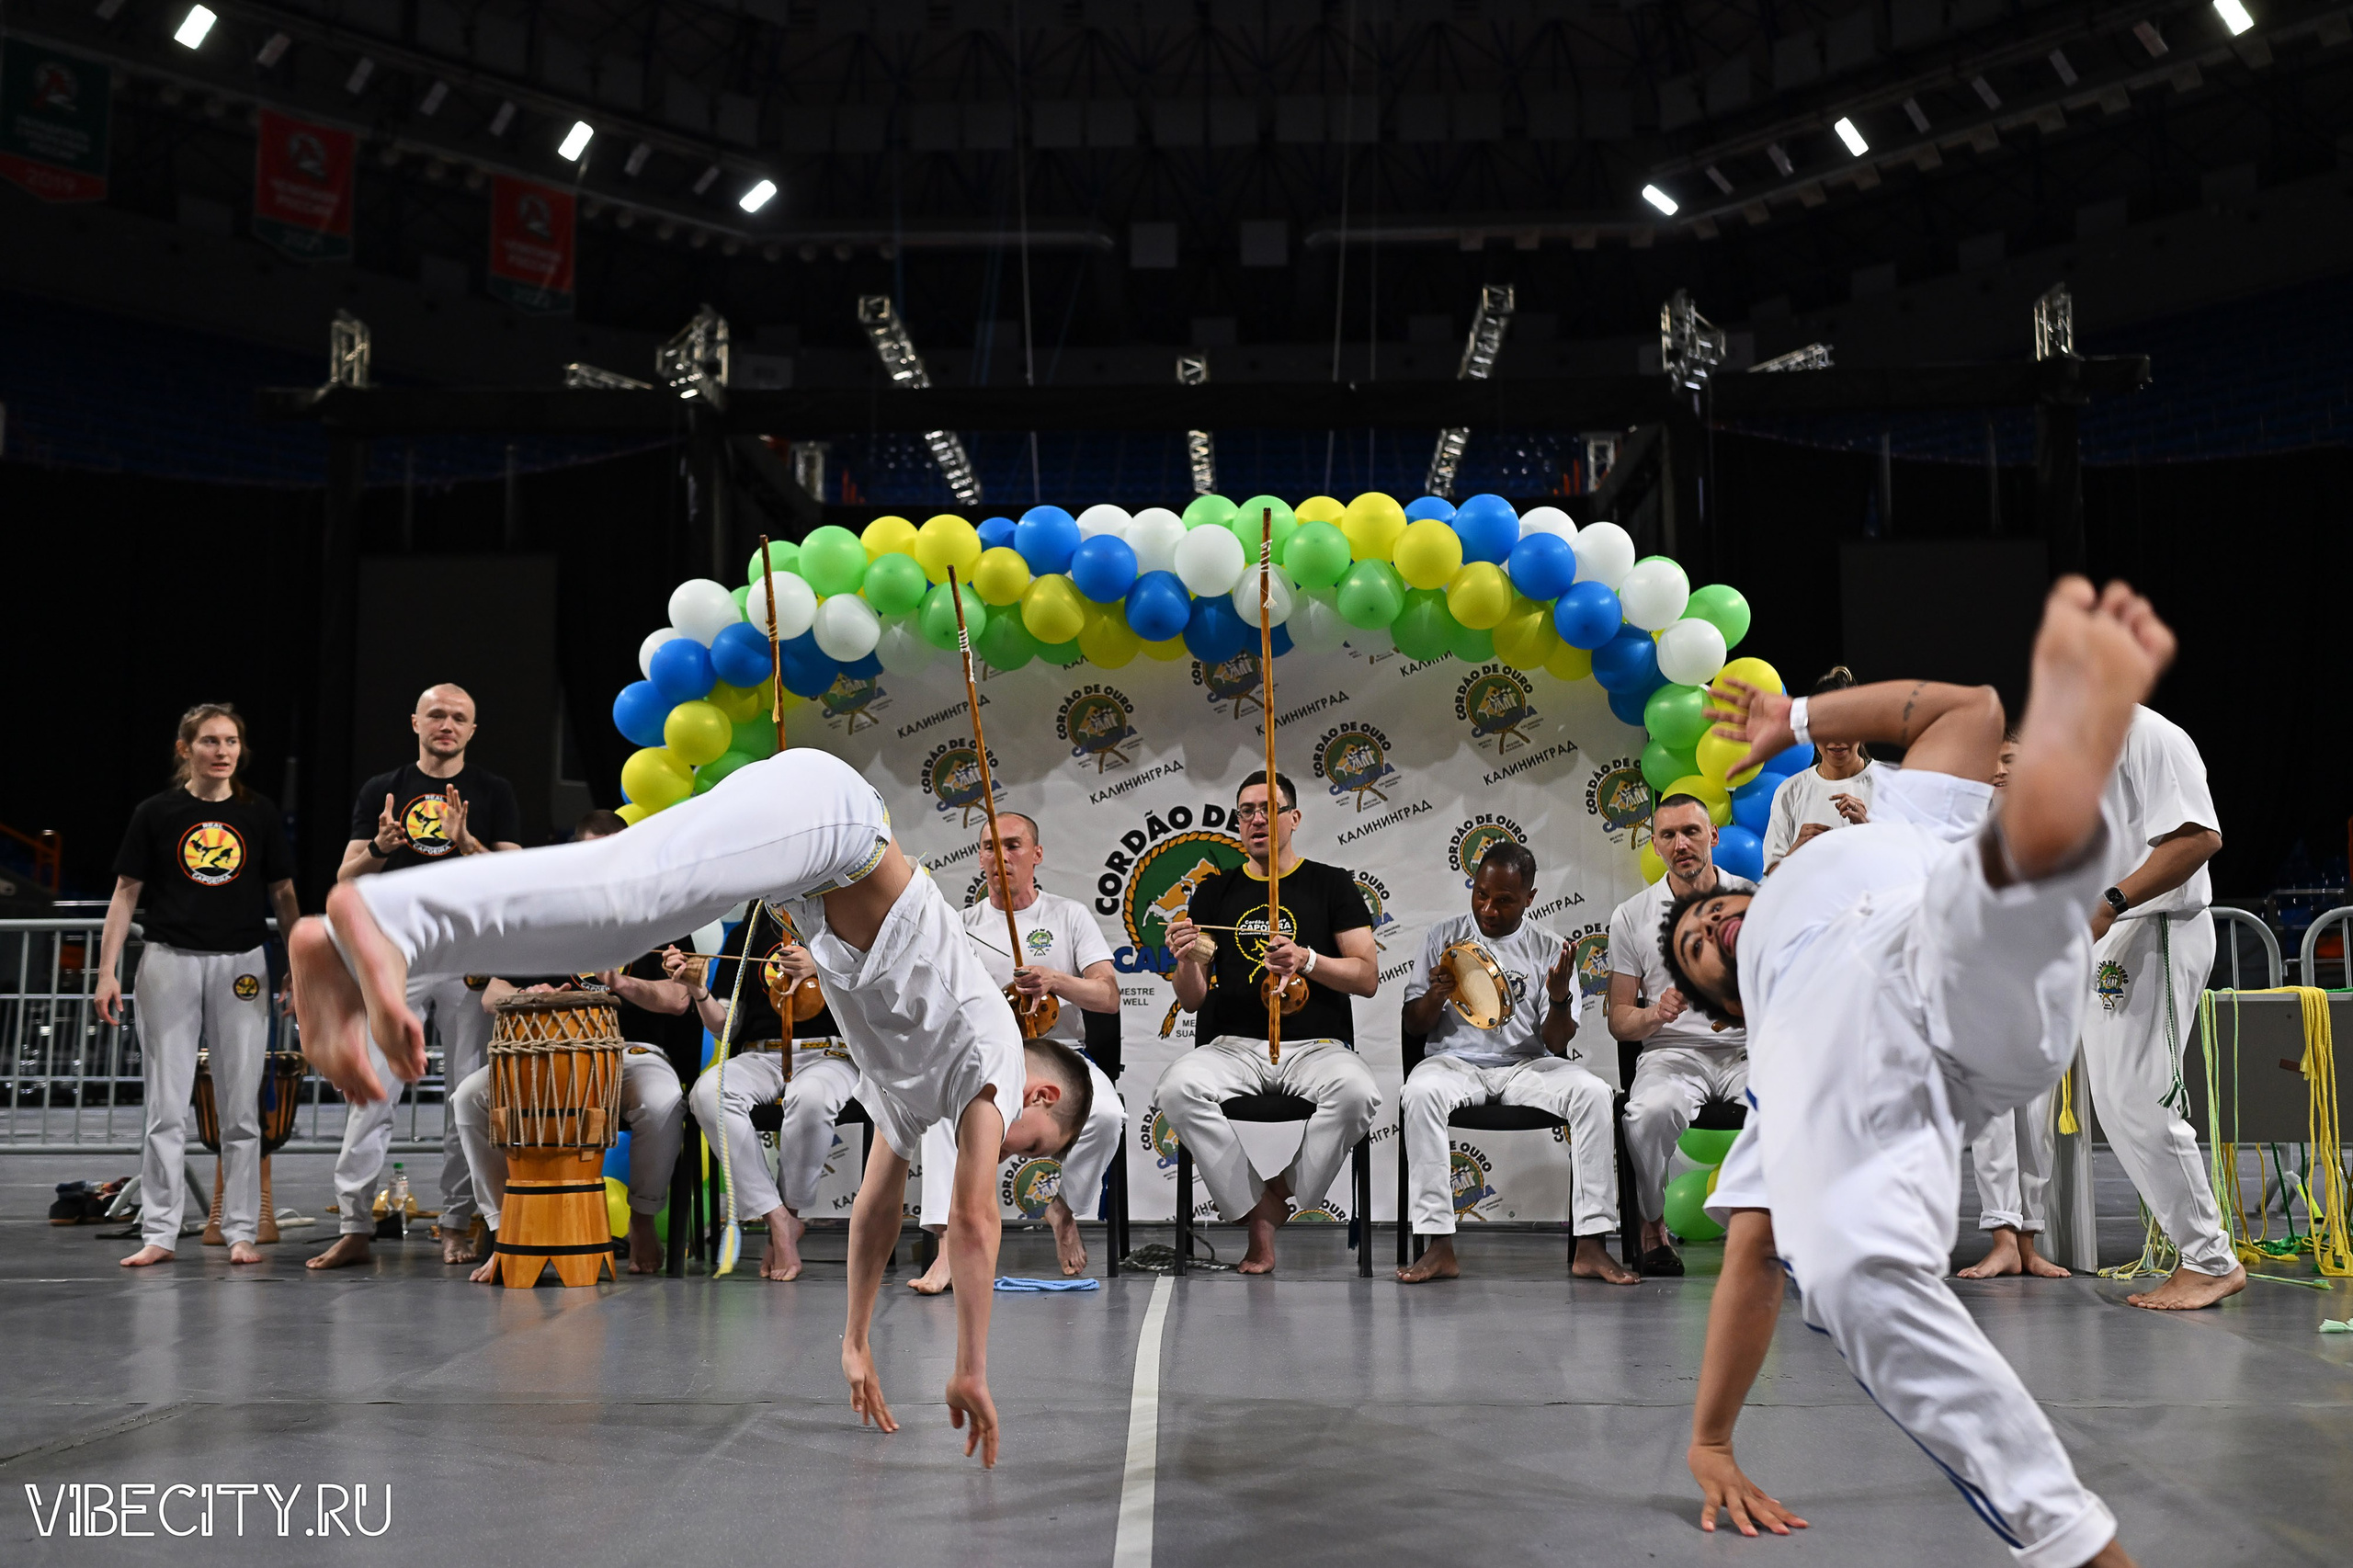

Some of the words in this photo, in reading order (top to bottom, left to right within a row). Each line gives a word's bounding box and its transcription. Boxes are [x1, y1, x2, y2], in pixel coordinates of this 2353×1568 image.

[1056, 689, 1082, 740] CORDÃO
[1084, 684, 1101, 695] DE
[1104, 686, 1134, 714] OURO
[1256, 690, 1349, 736] КЛИНИНГРАД
[1455, 670, 1480, 721] CORDÃO
[1482, 664, 1499, 674] DE
[1502, 665, 1533, 694] OURO
[921, 744, 947, 794] CORDÃO
[949, 738, 965, 749] DE
[969, 740, 998, 767] ORO
[1313, 728, 1338, 778] CORDÃO
[1340, 722, 1357, 733] DE
[1360, 723, 1392, 751] OURO
[1483, 740, 1578, 786] КАЛИНИНГРАД
[1089, 760, 1184, 804] КАЛИНИНГРАД
[1586, 765, 1610, 815] CORDÃO
[1612, 757, 1630, 768] DE
[1337, 800, 1432, 846] КАЛИНИНГРАД
[1449, 820, 1473, 871] CORDÃO
[1475, 813, 1493, 825] DE
[1495, 815, 1527, 844] OURO
[1095, 806, 1193, 915] CORDÃO
[1358, 871, 1390, 900] OURO
[1240, 922, 1291, 932] CAPORA
[1584, 923, 1601, 935] DE
[1460, 1142, 1492, 1172] OURO
